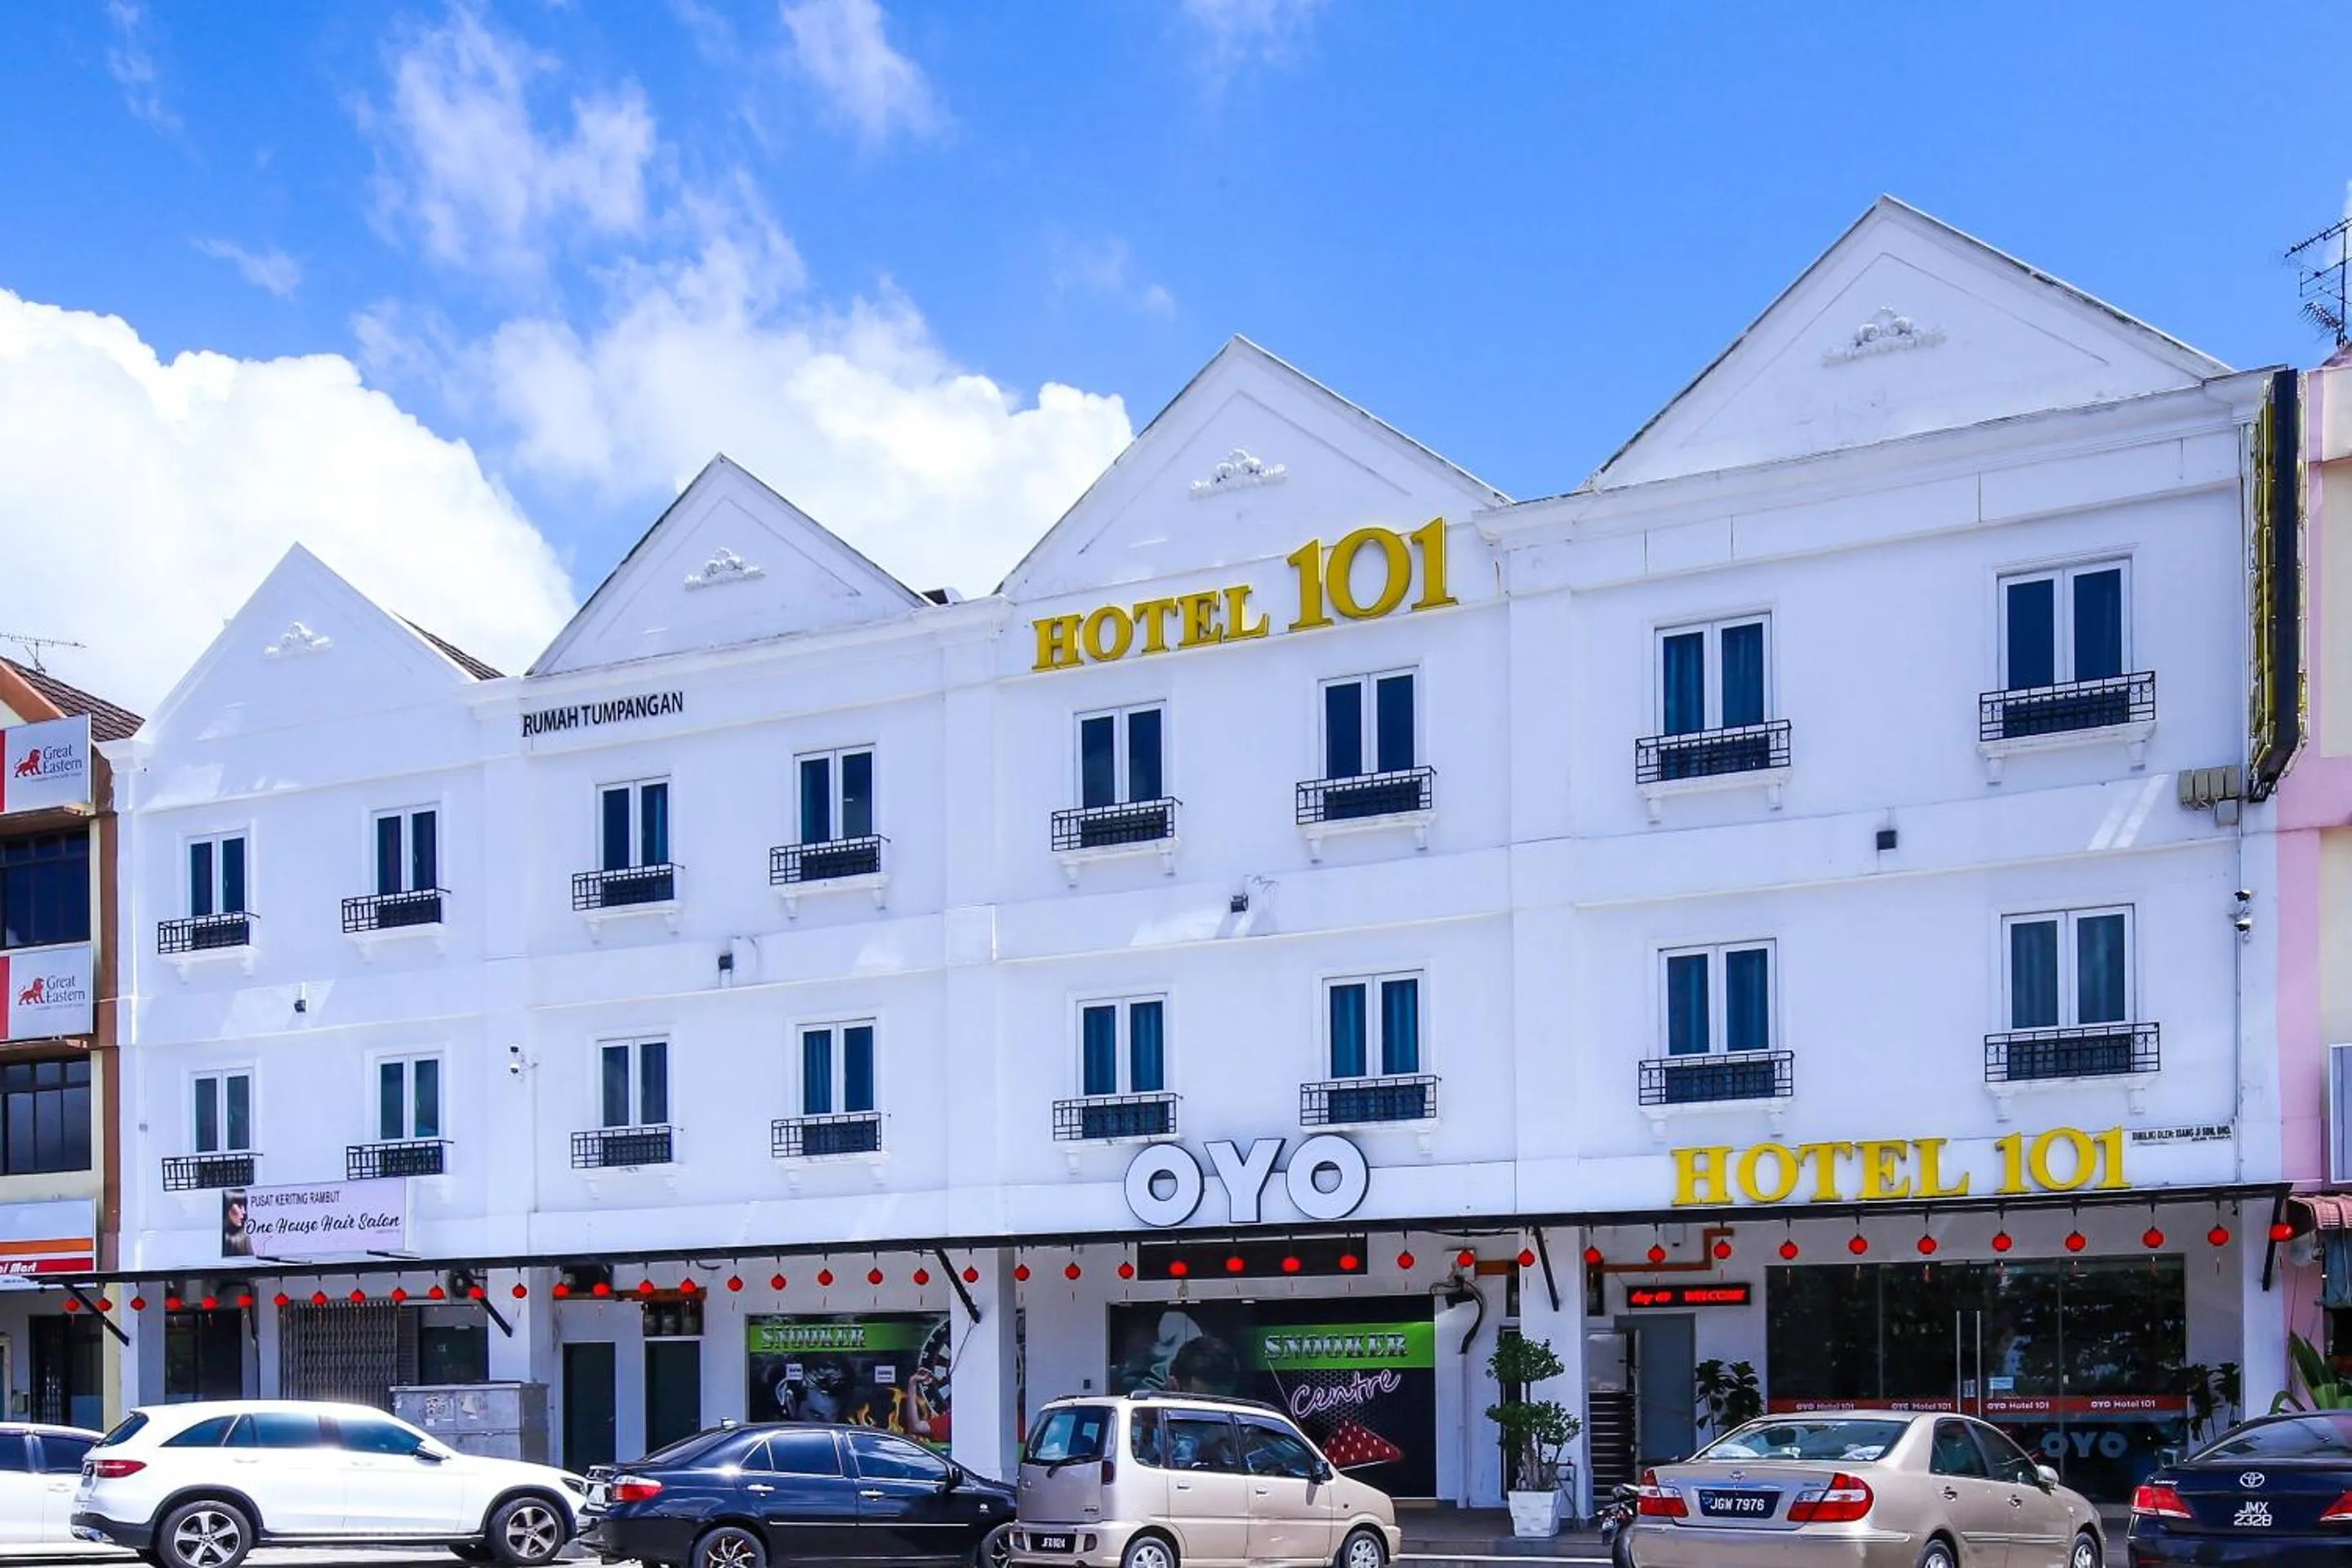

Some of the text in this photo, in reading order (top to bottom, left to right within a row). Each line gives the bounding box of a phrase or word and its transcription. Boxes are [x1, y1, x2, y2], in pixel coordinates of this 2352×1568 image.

[1031, 515, 1458, 672] HOTEL 101
[522, 691, 683, 737] RUMAH TUMPANGAN
[43, 744, 73, 760] Great
[43, 759, 82, 774] Eastern
[47, 975, 76, 990] Great
[47, 990, 86, 1004] Eastern
[1670, 1125, 2132, 1206] HOTEL 101
[1124, 1132, 1370, 1228] OYO
[250, 1191, 341, 1208] PUSAT KERITING RAMBUT
[245, 1212, 400, 1235] One House Hair Salon
[10, 1262, 37, 1274] Mart
[761, 1325, 866, 1349] SNOOKER
[1264, 1332, 1408, 1358] SNOOKER
[1290, 1369, 1401, 1419] Centre
[2009, 1401, 2034, 1410] Hotel
[2114, 1400, 2139, 1408] Hotel
[2141, 1400, 2155, 1408] 101
[2042, 1431, 2127, 1459] OYO
[1710, 1498, 1765, 1511] JGW 7976
[2238, 1501, 2269, 1514] JMX
[2234, 1513, 2273, 1526] 2328
